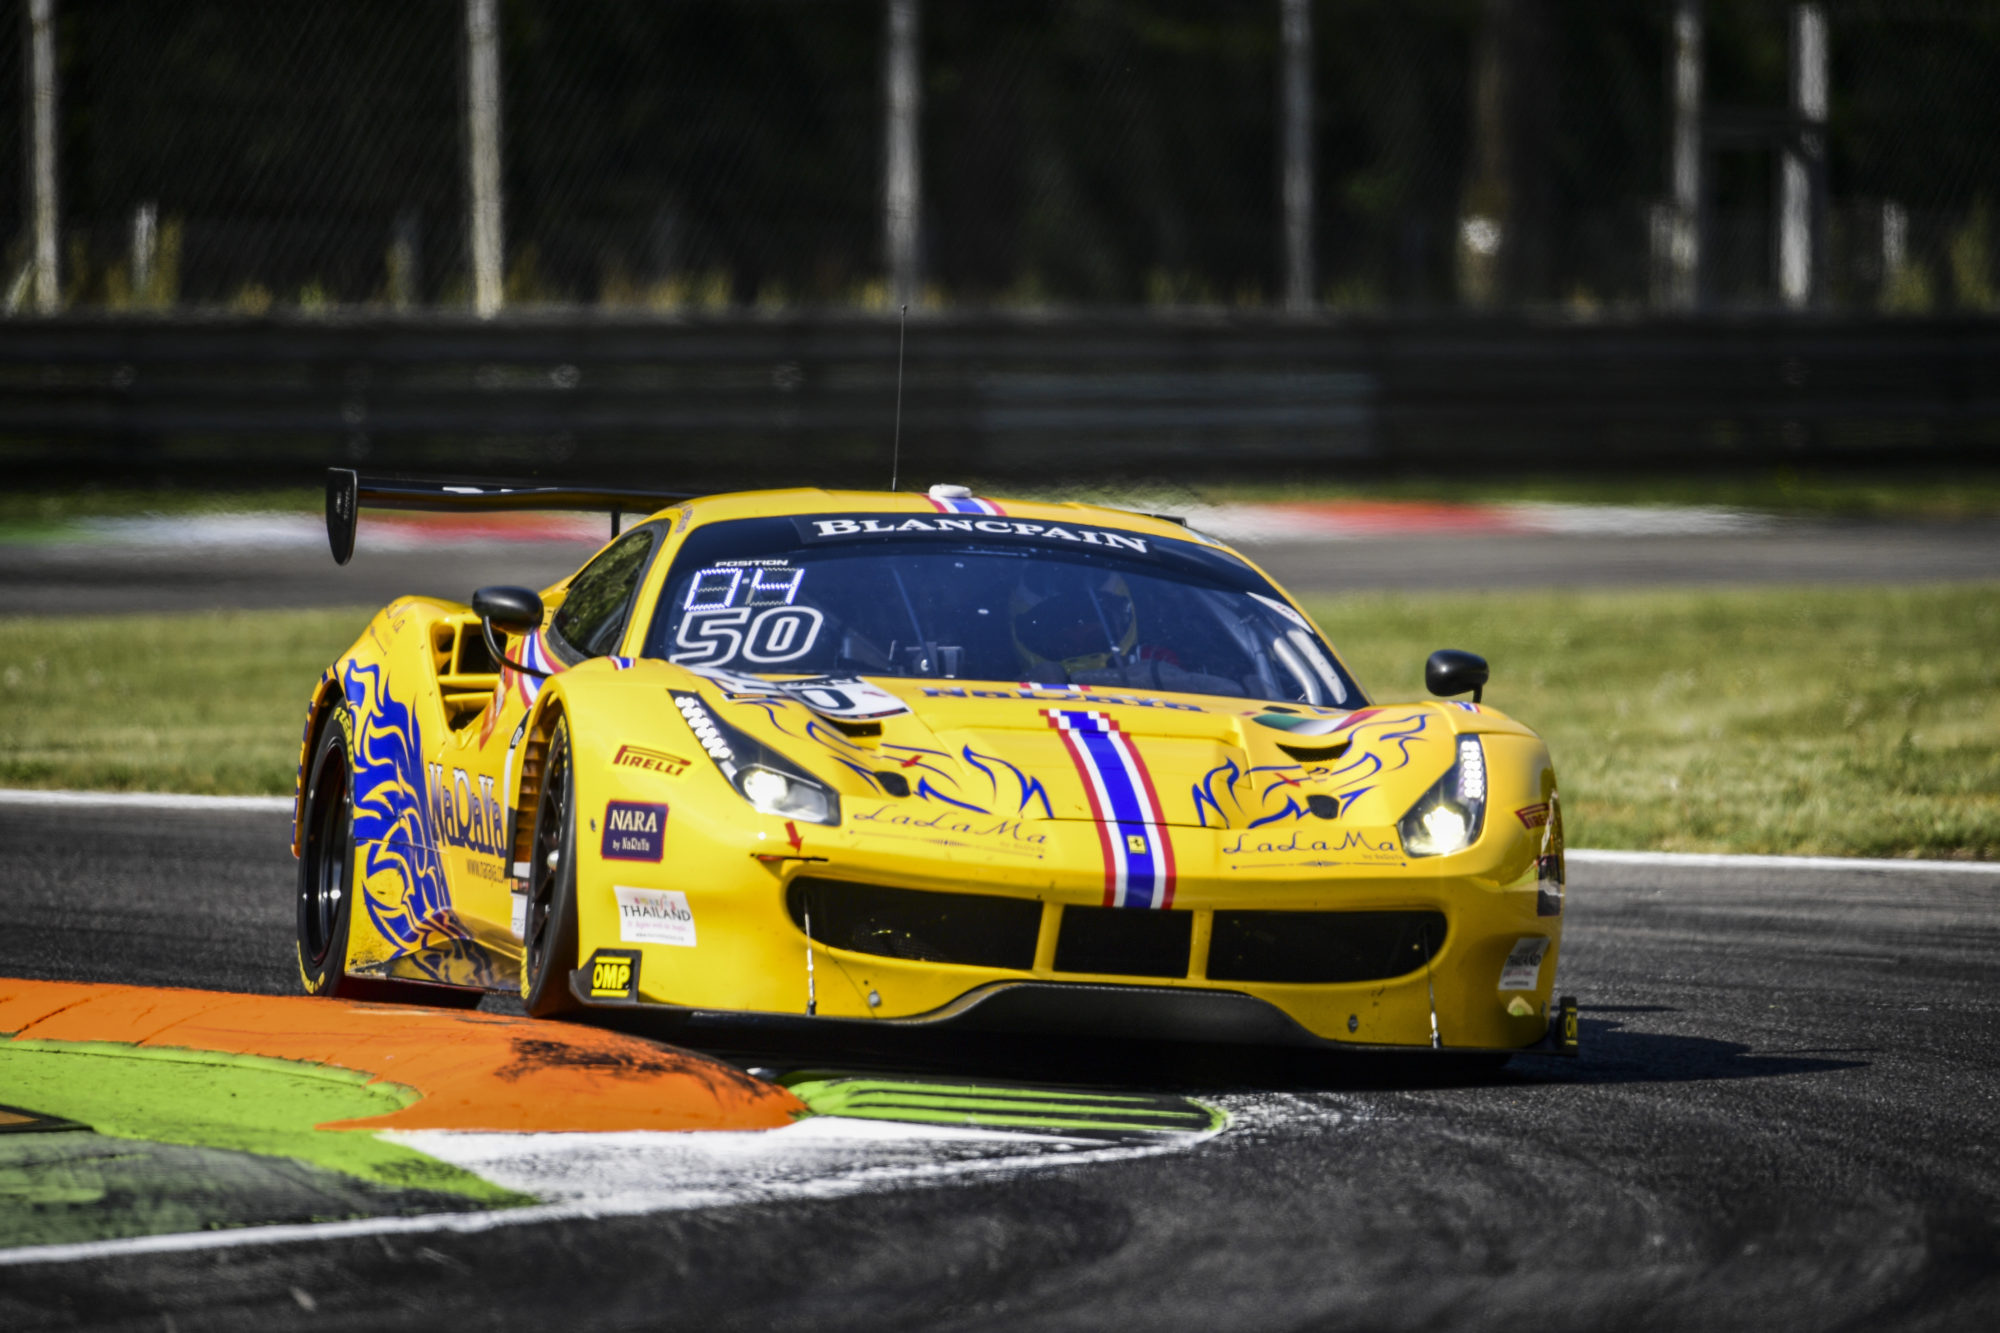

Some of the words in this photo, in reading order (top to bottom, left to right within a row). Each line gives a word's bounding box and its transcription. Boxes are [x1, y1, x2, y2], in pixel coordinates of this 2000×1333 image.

[812, 518, 1148, 554] BLANCPAIN
[714, 559, 789, 568] POSITION
[668, 605, 824, 668] 50
[613, 744, 692, 776] PIRELLI
[609, 809, 657, 833] NARA
[621, 904, 692, 922] THAILAND
[593, 964, 630, 990] OMP
